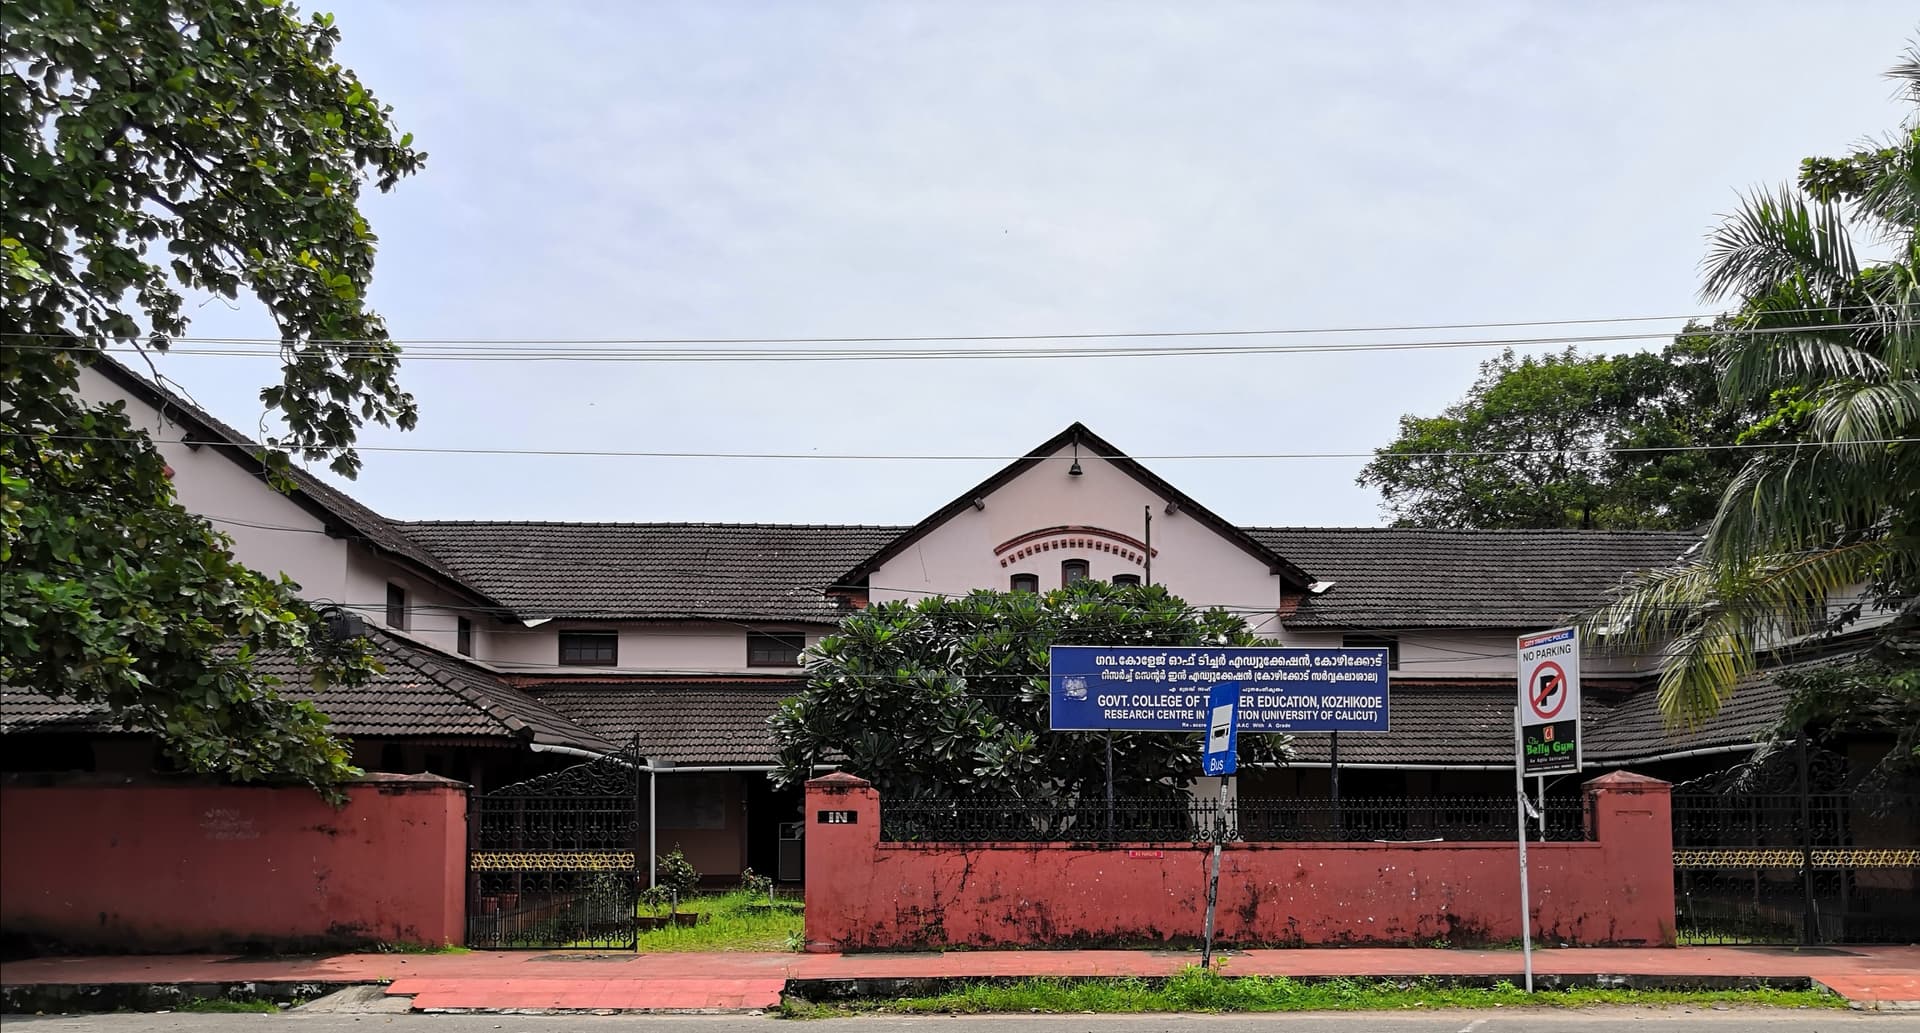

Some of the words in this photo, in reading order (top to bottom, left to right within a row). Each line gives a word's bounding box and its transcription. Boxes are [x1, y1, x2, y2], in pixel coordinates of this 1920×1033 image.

[1169, 653, 1196, 666] ഓഫ്
[1523, 651, 1535, 662] NO
[1536, 644, 1571, 660] PARKING
[1097, 695, 1130, 707] GOVT.
[1132, 695, 1183, 707] COLLEGE
[1185, 695, 1201, 707] OF
[1257, 696, 1320, 709] EDUCATION,
[1321, 696, 1383, 709] KOZHIKODE
[1104, 709, 1155, 720] RESEARCH
[1156, 710, 1194, 720] CENTRE
[1196, 710, 1205, 720] IN
[1261, 710, 1319, 722] (UNIVERSITY
[1320, 711, 1334, 721] OF
[1335, 711, 1378, 723] CALICUT)
[1526, 743, 1550, 756] Belly
[1553, 741, 1574, 755] Gym
[1210, 758, 1224, 772] Bus
[828, 811, 848, 823] IN
